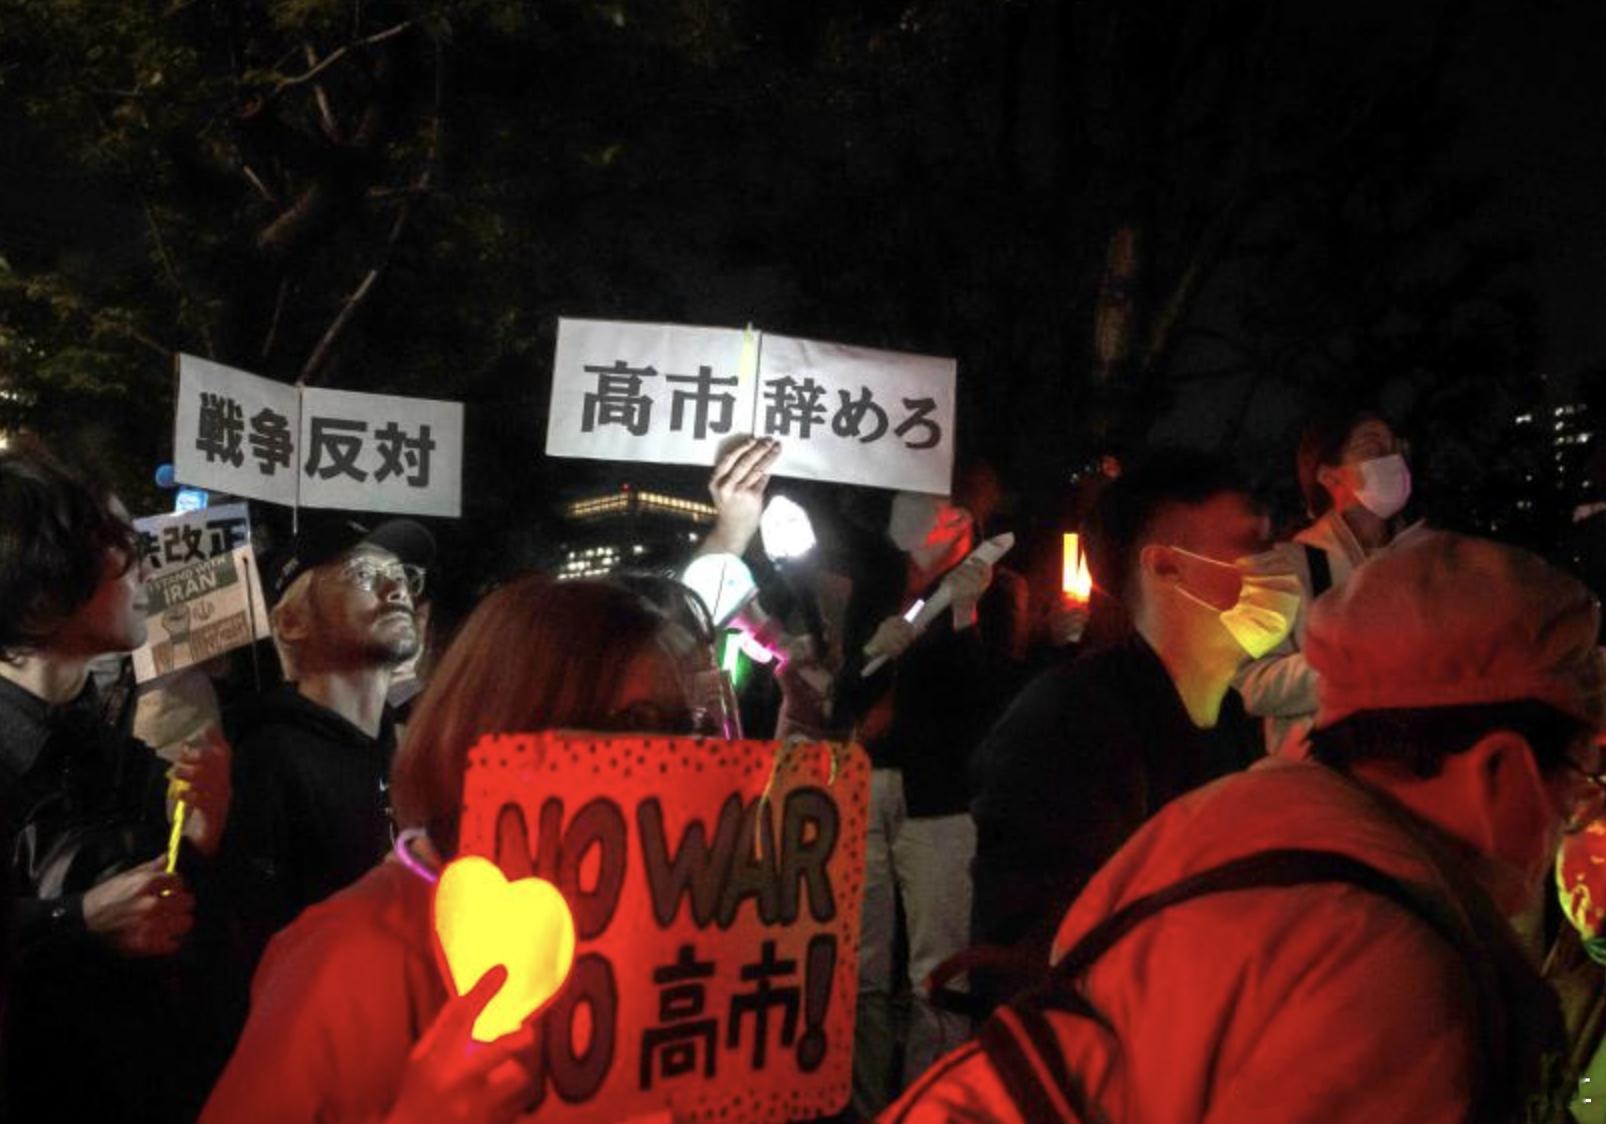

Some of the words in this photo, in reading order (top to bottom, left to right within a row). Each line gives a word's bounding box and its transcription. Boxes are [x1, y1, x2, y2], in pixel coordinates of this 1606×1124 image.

[195, 391, 437, 489] 戦争反対
[581, 360, 942, 450] 高市辞めろ
[163, 571, 217, 604] IRAN
[636, 785, 840, 932] WAR
[526, 951, 619, 1116] O
